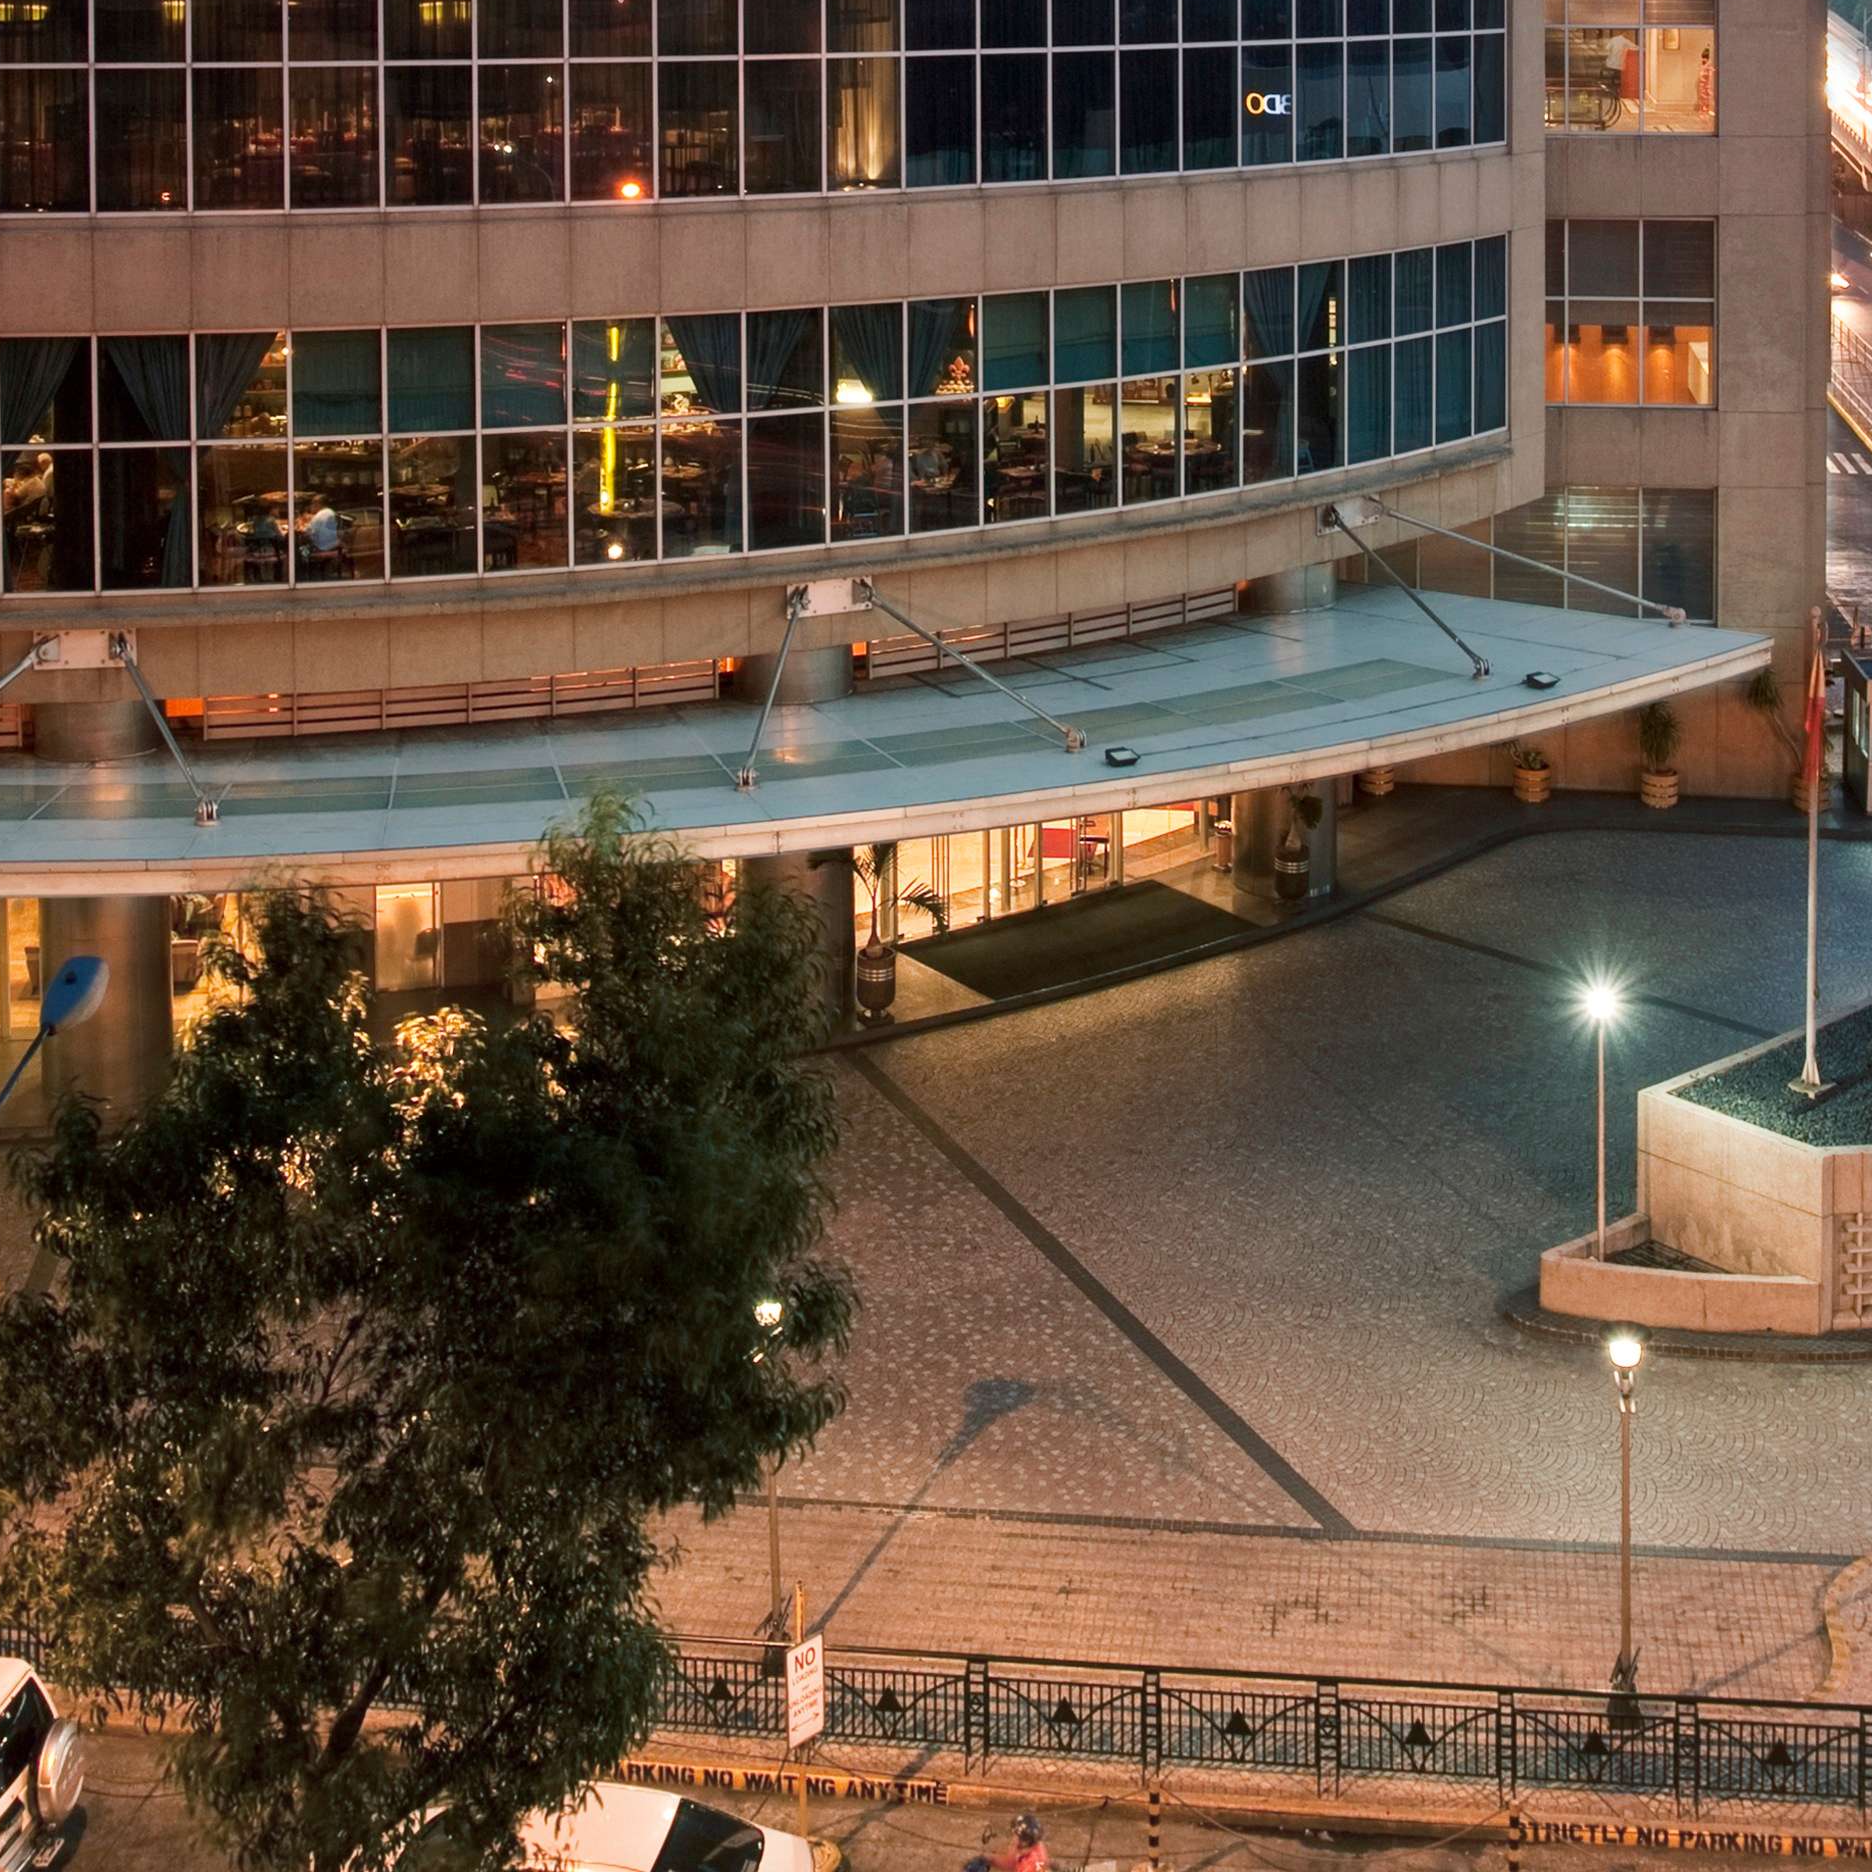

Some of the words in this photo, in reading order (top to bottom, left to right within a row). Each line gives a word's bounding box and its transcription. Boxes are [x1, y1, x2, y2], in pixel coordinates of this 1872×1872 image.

[794, 1647, 816, 1673] NO
[615, 1762, 695, 1784] ARKING
[703, 1769, 733, 1790] NO
[743, 1772, 836, 1796] WAITNG
[845, 1780, 949, 1805] ANYTIME
[1637, 1826, 1669, 1847] NO
[1678, 1831, 1782, 1855] PARKING
[1792, 1836, 1824, 1856] NO
